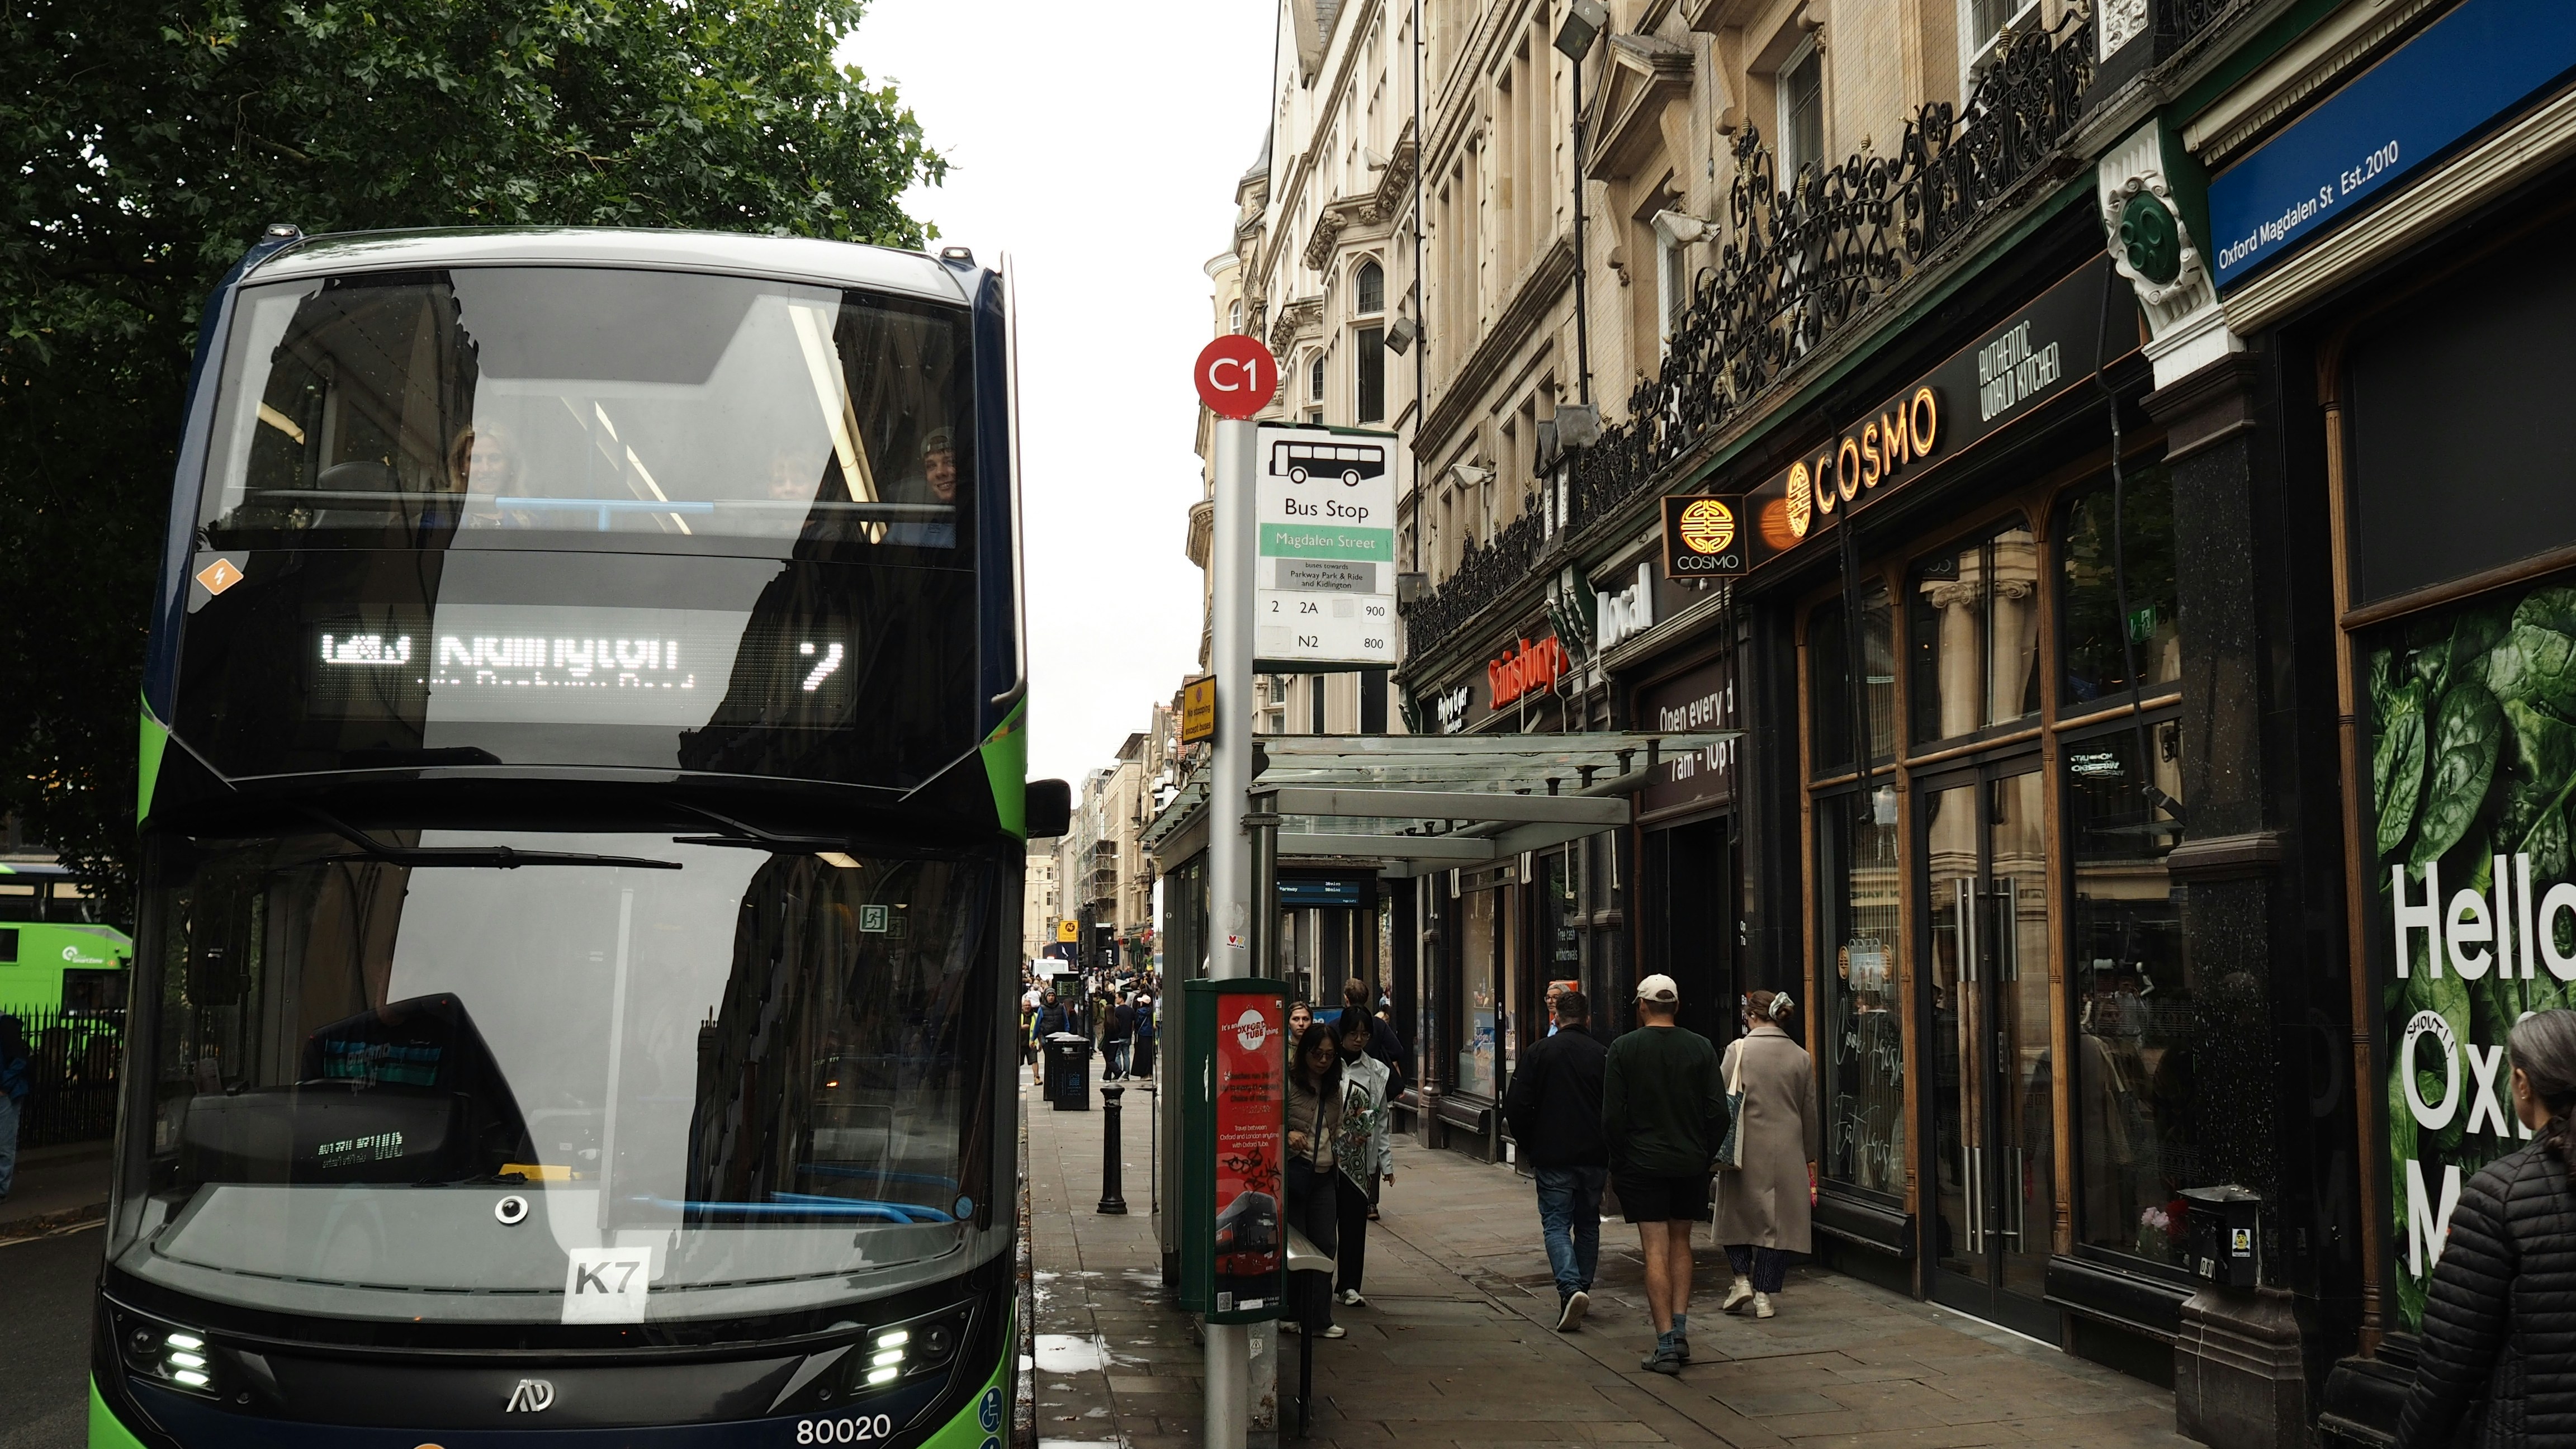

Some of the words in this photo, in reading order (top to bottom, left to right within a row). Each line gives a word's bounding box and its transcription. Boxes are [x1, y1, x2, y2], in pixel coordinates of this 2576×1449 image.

[2218, 230, 2258, 269] Oxford
[2259, 197, 2317, 245] Magdalen
[2320, 184, 2334, 209] St
[2341, 140, 2399, 196] Est.2010
[1978, 320, 2032, 386] AUTHENTIC
[1209, 358, 1256, 392] C1
[1981, 370, 2016, 422] WORLD
[2016, 342, 2061, 401] KITCHEN
[1815, 385, 1936, 514] COSMO
[1285, 498, 1318, 516] Bus
[1326, 500, 1368, 523] Stop
[1277, 532, 1333, 549] Magdalen
[1338, 535, 1376, 549] Street
[1678, 555, 1739, 570] COSMO
[1291, 571, 1319, 579] Parkway
[1317, 581, 1352, 590] Kidlington
[1272, 600, 1279, 612] 2
[1300, 602, 1319, 614] 2A
[1366, 606, 1385, 617] 900
[1597, 562, 1653, 652] Local
[1299, 635, 1319, 647] N2
[1364, 638, 1384, 649] 800
[1187, 708, 1193, 717] No
[1194, 704, 1211, 716] stopping
[1660, 706, 1687, 731] Open
[1689, 690, 1722, 727] every
[1186, 723, 1200, 735] except
[1199, 722, 1211, 732] buses
[2392, 853, 2576, 981] Hello
[1557, 928, 1566, 941] Free
[1237, 1021, 1266, 1034] OXFORD
[1246, 1029, 1264, 1040] TUBE
[1266, 1027, 1279, 1036] thing
[575, 1261, 641, 1296] K7
[796, 1413, 891, 1445] 80020
